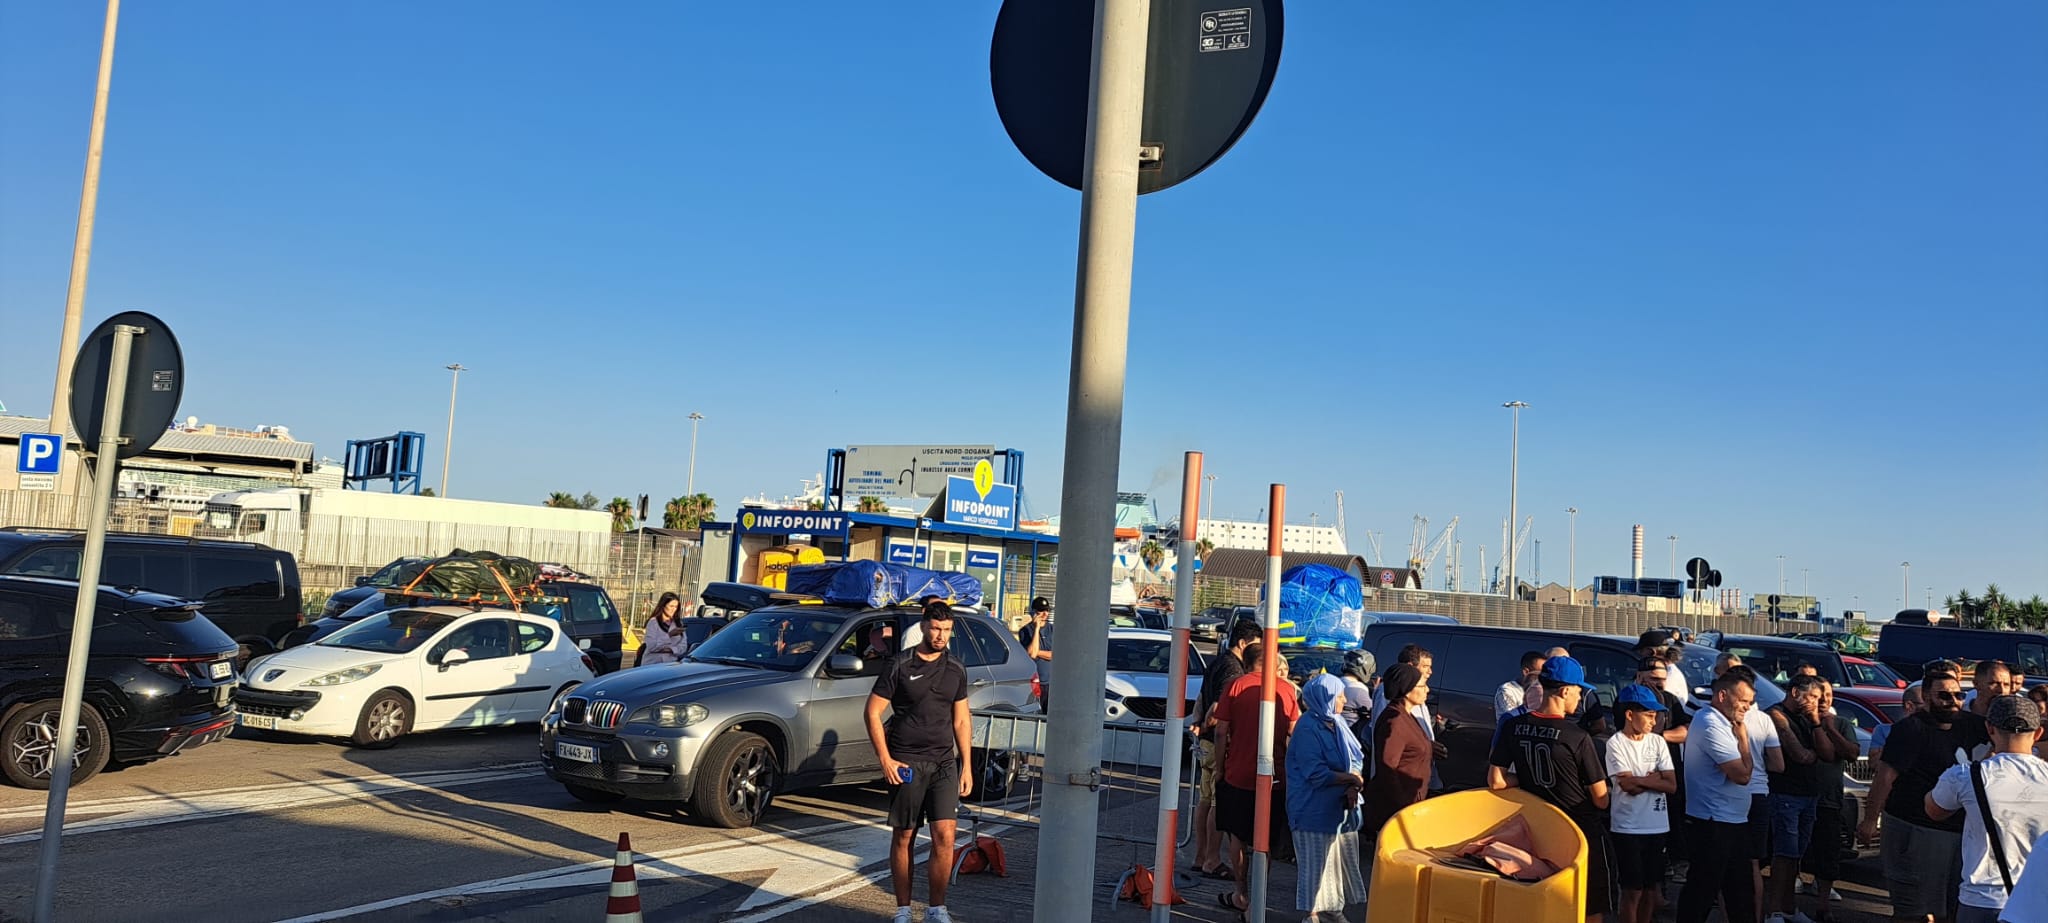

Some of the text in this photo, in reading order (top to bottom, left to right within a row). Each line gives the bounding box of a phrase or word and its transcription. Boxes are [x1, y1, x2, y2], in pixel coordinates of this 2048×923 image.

[26, 438, 53, 469] P
[951, 499, 1010, 519] INFOPOINT
[756, 515, 843, 530] INFOPOINT
[1514, 723, 1561, 740] KHAZRI
[1519, 740, 1557, 788] 10
